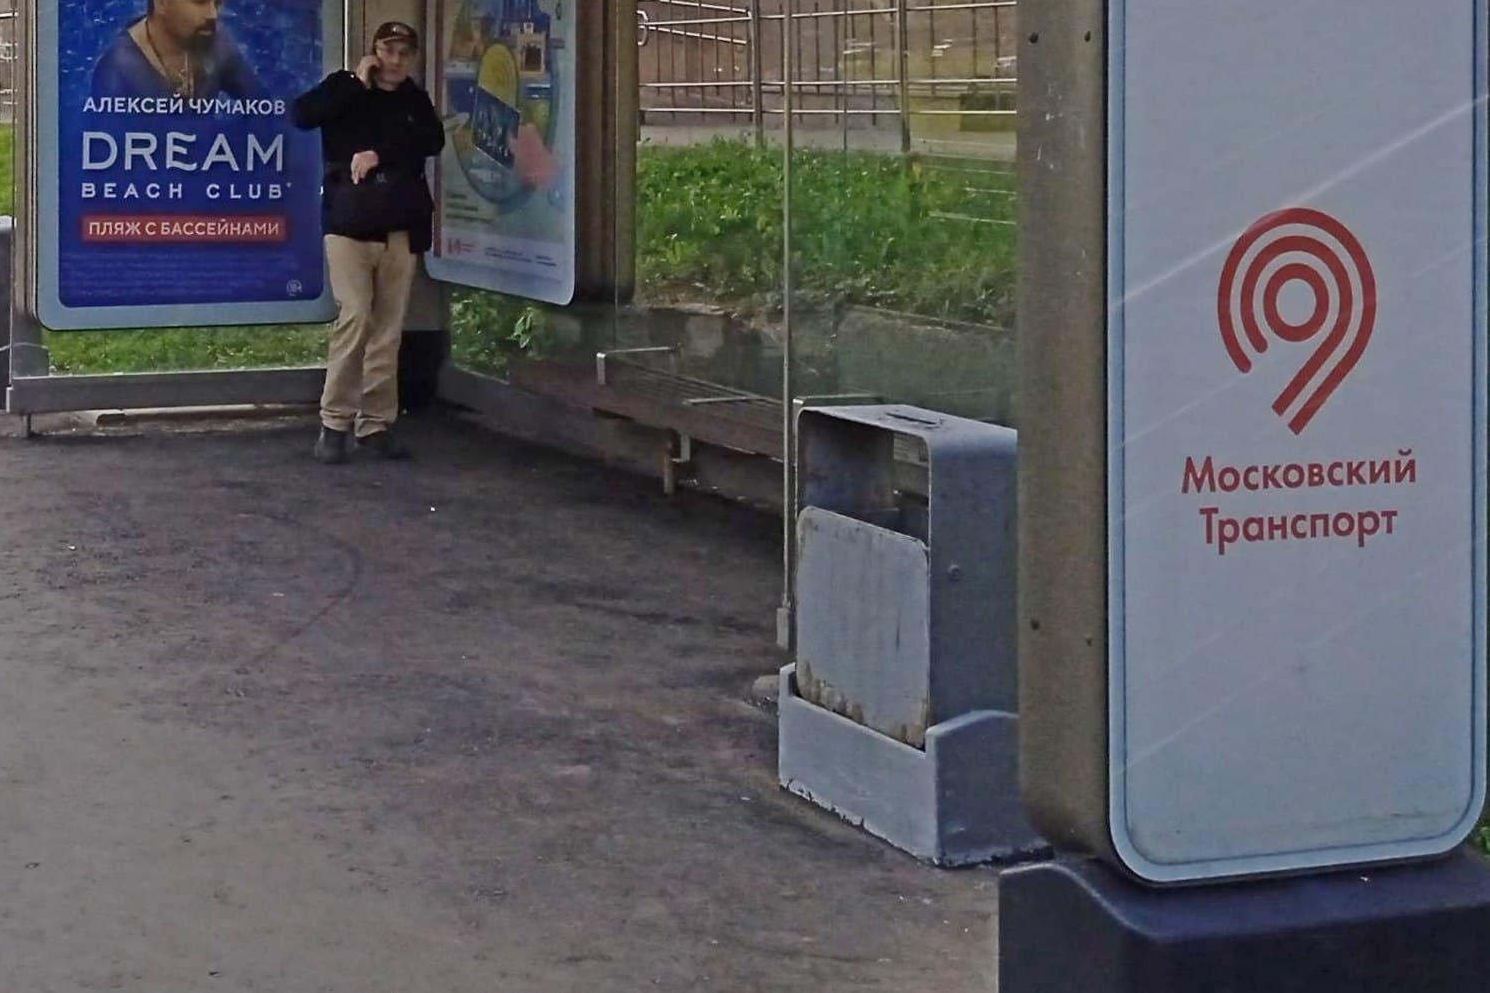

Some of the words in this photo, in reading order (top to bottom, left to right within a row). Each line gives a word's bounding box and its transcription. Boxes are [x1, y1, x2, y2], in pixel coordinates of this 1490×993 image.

[83, 94, 184, 114] АЛЕКСЕЙ
[189, 99, 286, 115] ЧУМАКОВ
[82, 130, 284, 172] DREAM
[81, 182, 184, 199] BEACH
[89, 222, 141, 236] ПЛЯЖ
[145, 222, 157, 236] С
[160, 218, 280, 236] БАССЕЙНАМИ
[1182, 448, 1417, 494] Московский
[1200, 507, 1399, 555] Транспорт
